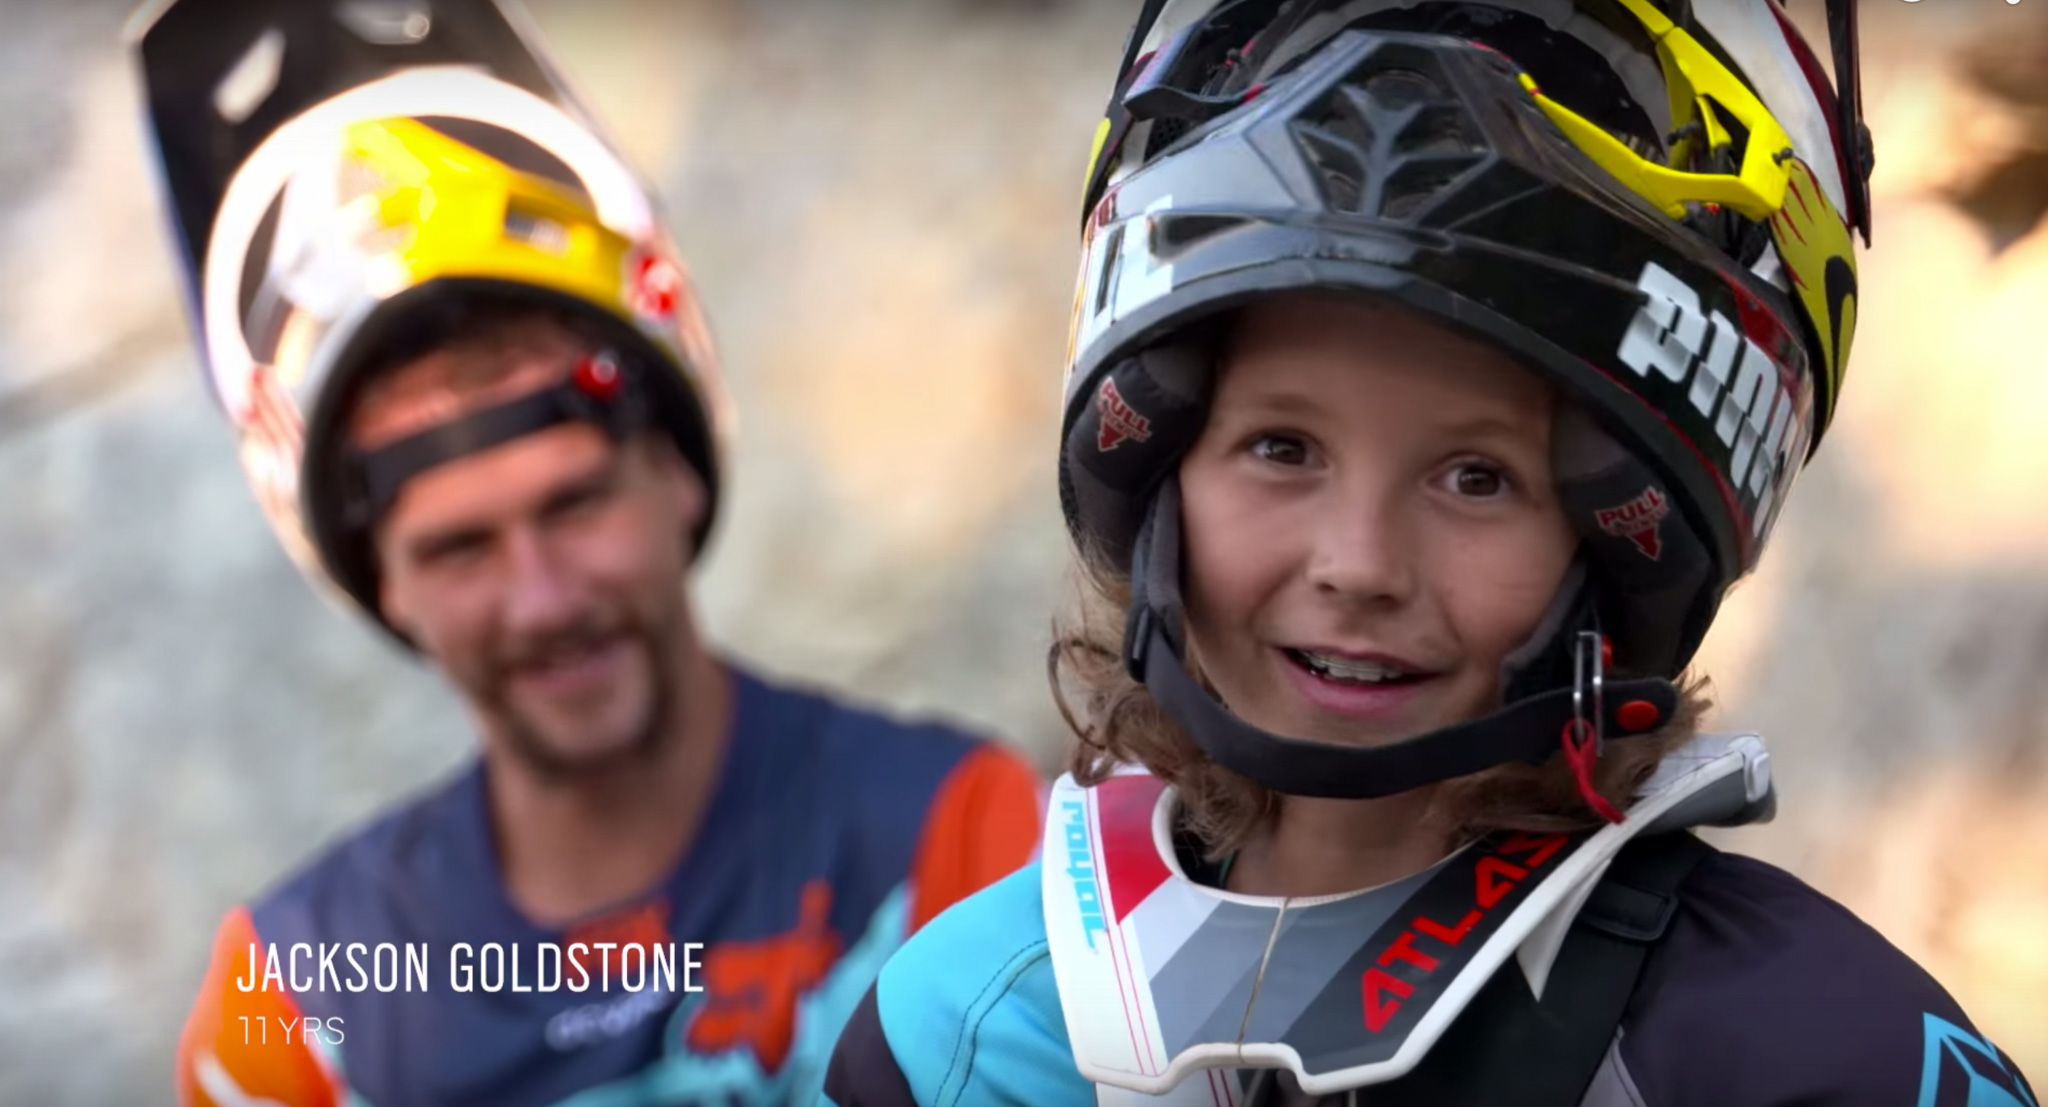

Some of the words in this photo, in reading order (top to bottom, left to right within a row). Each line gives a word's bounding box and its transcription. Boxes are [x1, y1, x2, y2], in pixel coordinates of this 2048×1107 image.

[1101, 379, 1149, 436] PULL
[1599, 489, 1663, 526] PULL
[1062, 801, 1108, 951] royal
[1361, 831, 1572, 1035] ATLAS
